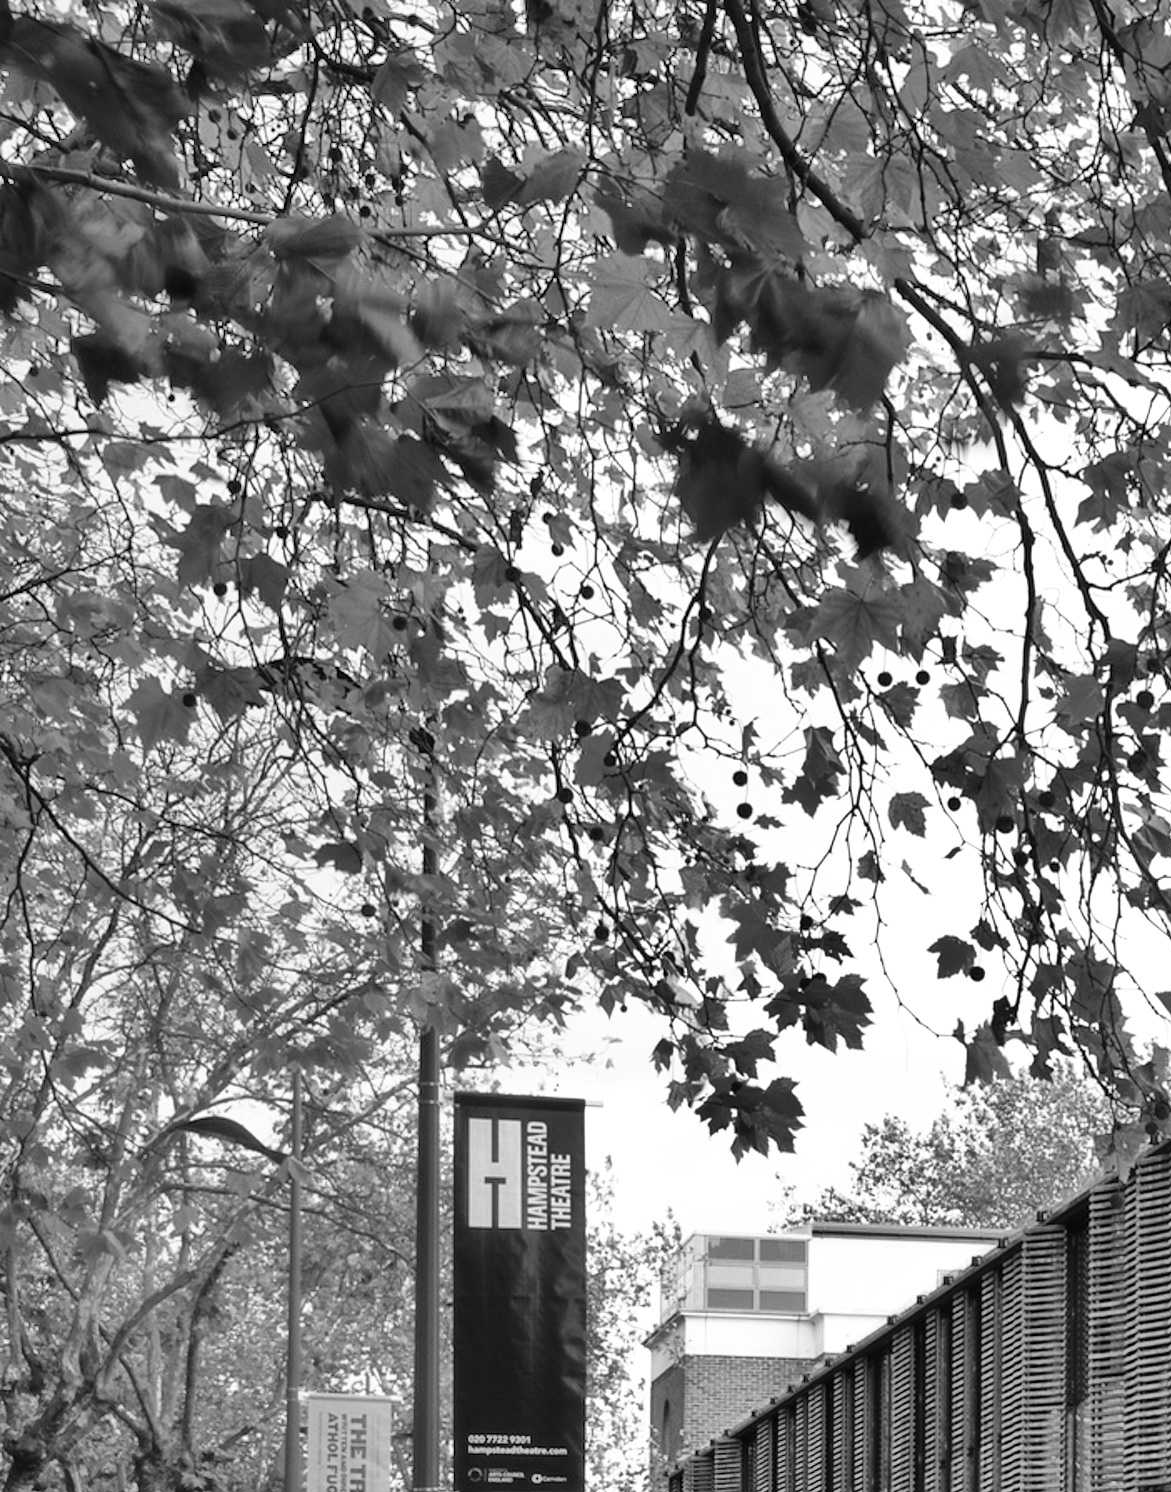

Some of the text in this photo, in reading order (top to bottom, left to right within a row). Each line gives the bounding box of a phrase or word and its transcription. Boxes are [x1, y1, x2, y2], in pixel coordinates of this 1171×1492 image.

[527, 1121, 548, 1231] HAMPSTEAD
[551, 1153, 571, 1231] THEATRE
[327, 1413, 338, 1462] ATHOL
[350, 1413, 367, 1460] THE
[467, 1434, 486, 1444] 020
[486, 1434, 509, 1445] 7722
[467, 1445, 568, 1456] hampsteadtheatre.com
